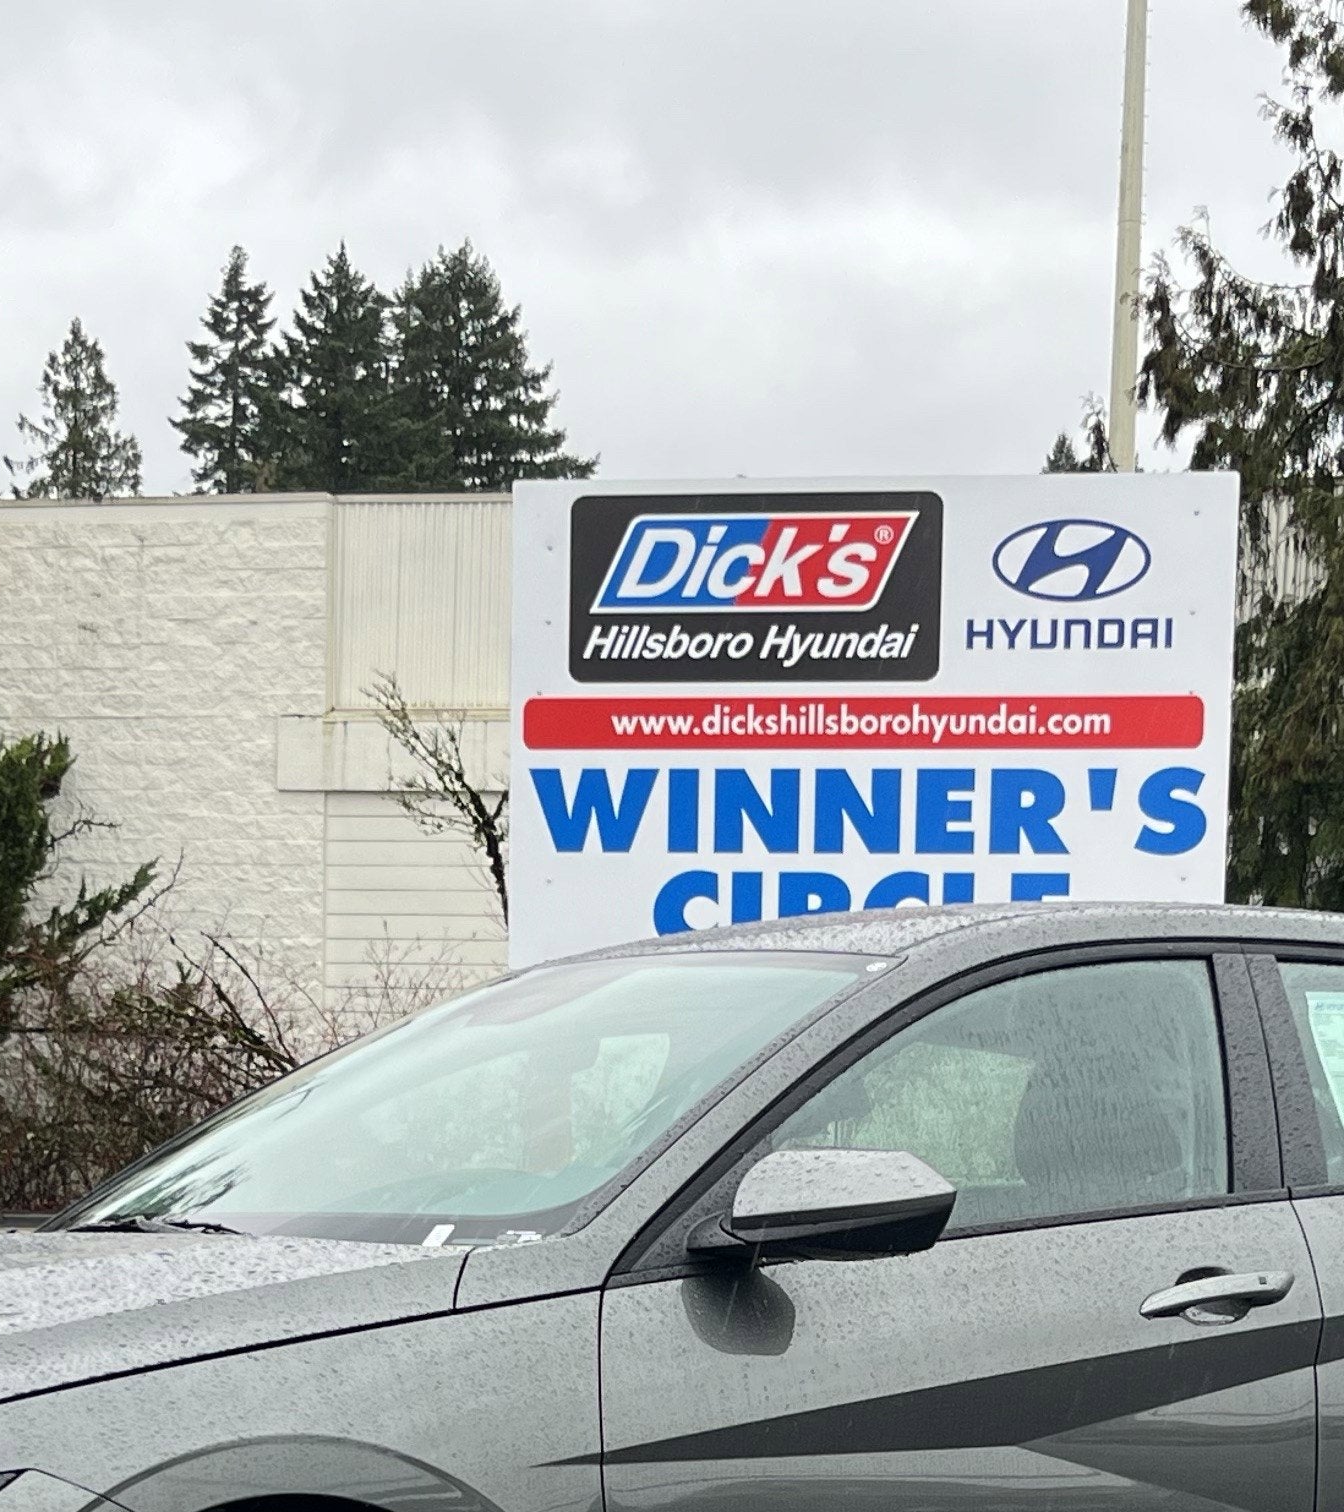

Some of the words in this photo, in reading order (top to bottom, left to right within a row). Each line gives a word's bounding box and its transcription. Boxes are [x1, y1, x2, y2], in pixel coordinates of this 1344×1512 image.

[615, 523, 878, 599] Dick's
[582, 624, 755, 661] Hillsboro
[758, 622, 920, 668] Hyundai
[965, 617, 1173, 649] HYUNDAI
[611, 703, 1111, 743] www.dickshillsborohyundai.com
[530, 766, 1207, 855] WINNER'S
